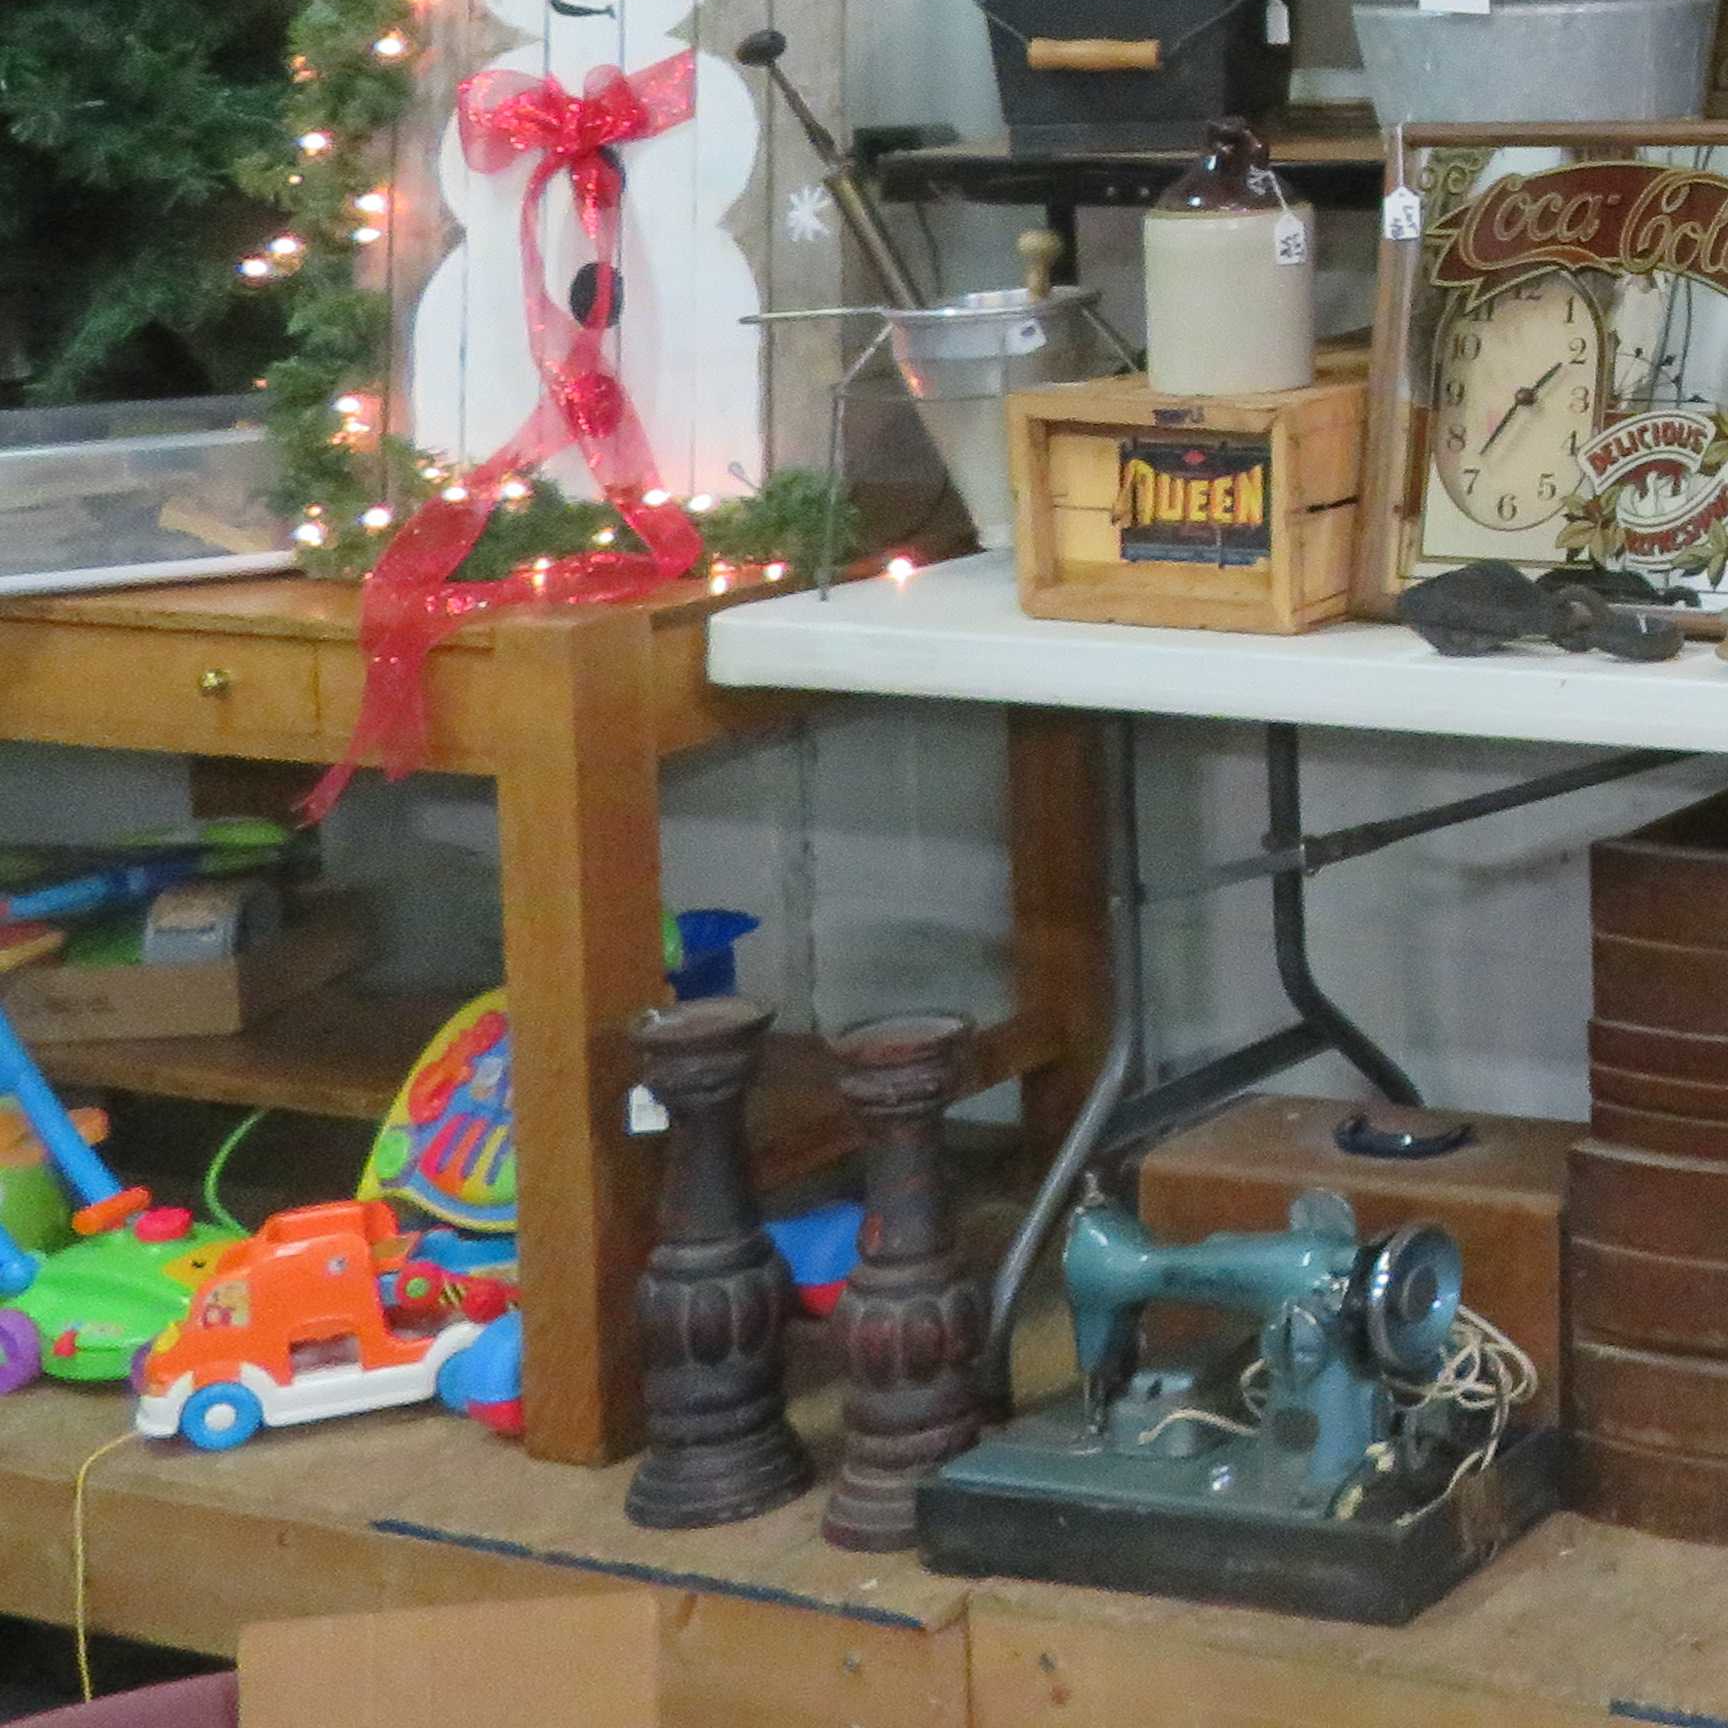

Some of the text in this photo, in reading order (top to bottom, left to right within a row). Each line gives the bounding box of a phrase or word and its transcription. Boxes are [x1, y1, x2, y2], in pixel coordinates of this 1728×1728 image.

[1568, 337, 1587, 365] 2
[1446, 379, 1465, 407] 9
[1569, 386, 1590, 414] 3
[1447, 423, 1466, 451] 8
[1586, 421, 1708, 478] DELICIOUS
[1463, 468, 1481, 496] 7
[1537, 473, 1557, 501] 5
[1497, 493, 1517, 522] 6
